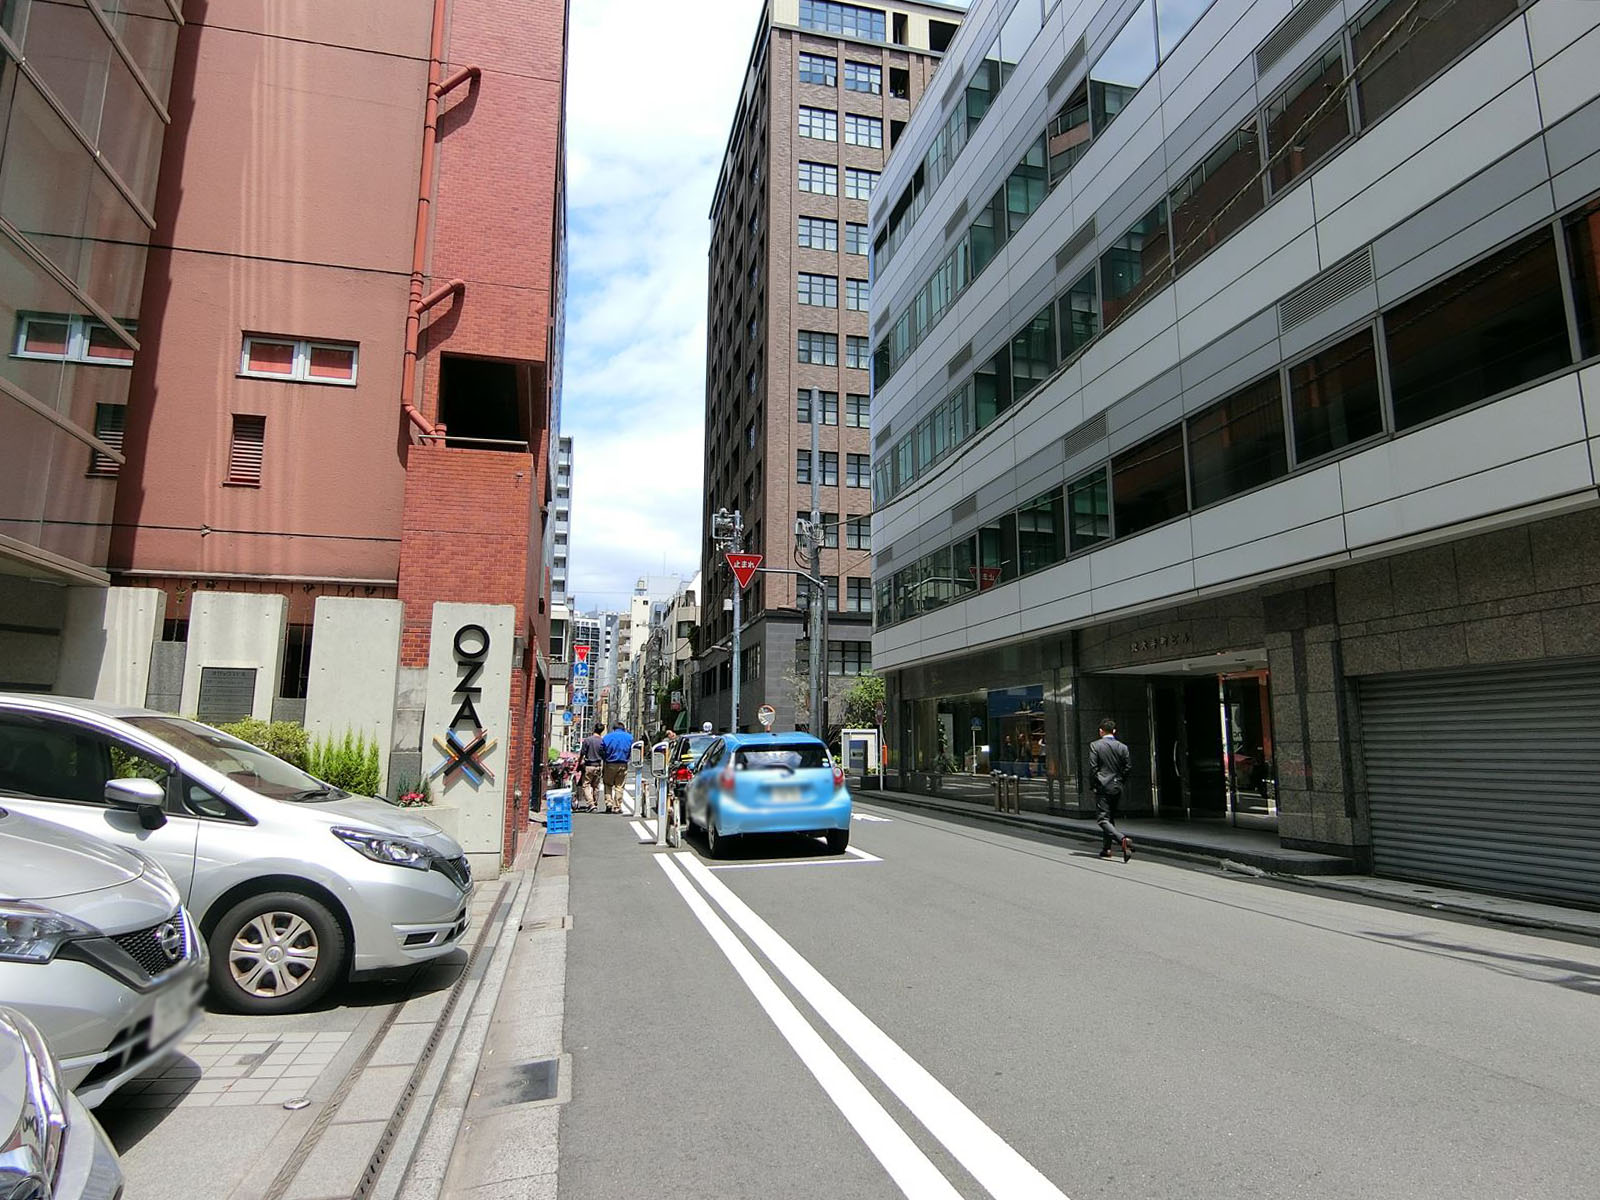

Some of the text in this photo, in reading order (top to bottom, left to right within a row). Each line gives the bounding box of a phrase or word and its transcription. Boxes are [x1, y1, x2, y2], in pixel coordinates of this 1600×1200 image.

[733, 560, 755, 569] 止まれ
[440, 623, 492, 780] OZAX
